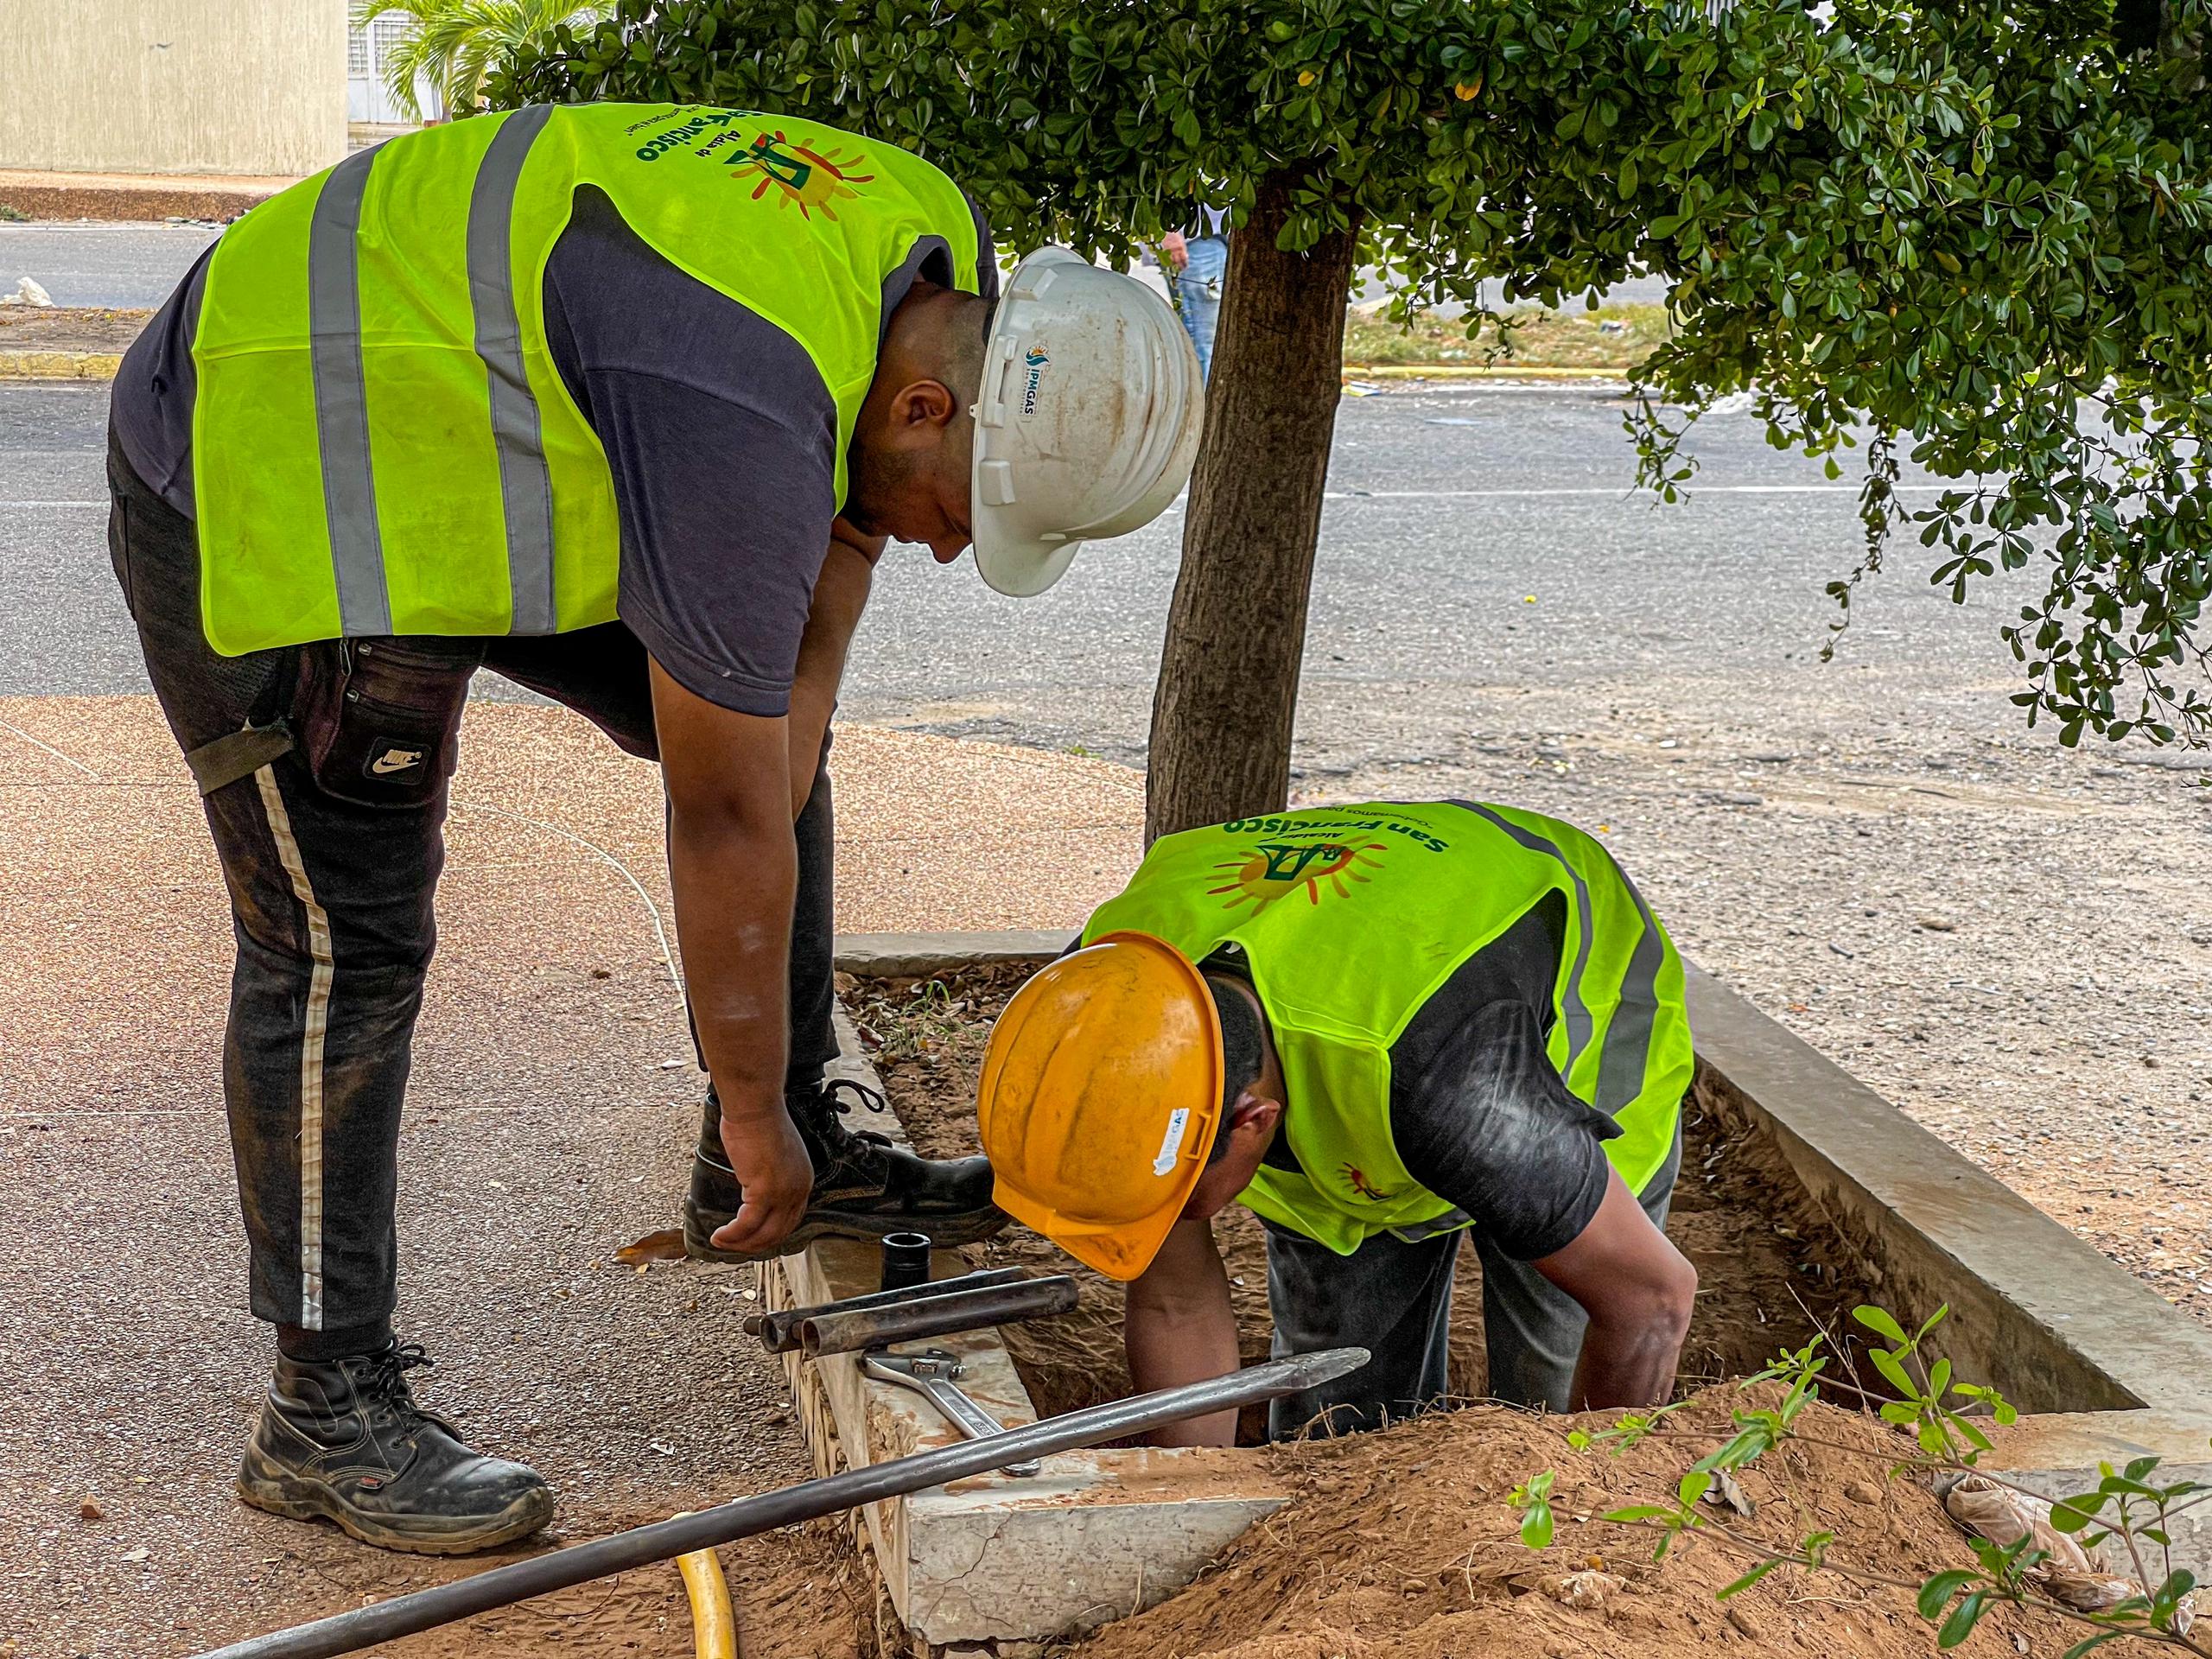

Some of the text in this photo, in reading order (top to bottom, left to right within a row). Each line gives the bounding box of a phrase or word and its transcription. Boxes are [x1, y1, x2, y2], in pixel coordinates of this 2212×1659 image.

[636, 114, 733, 162] Fancisco
[1025, 368, 1040, 415] IPMGAS
[1224, 817, 1449, 853] San Francisco
